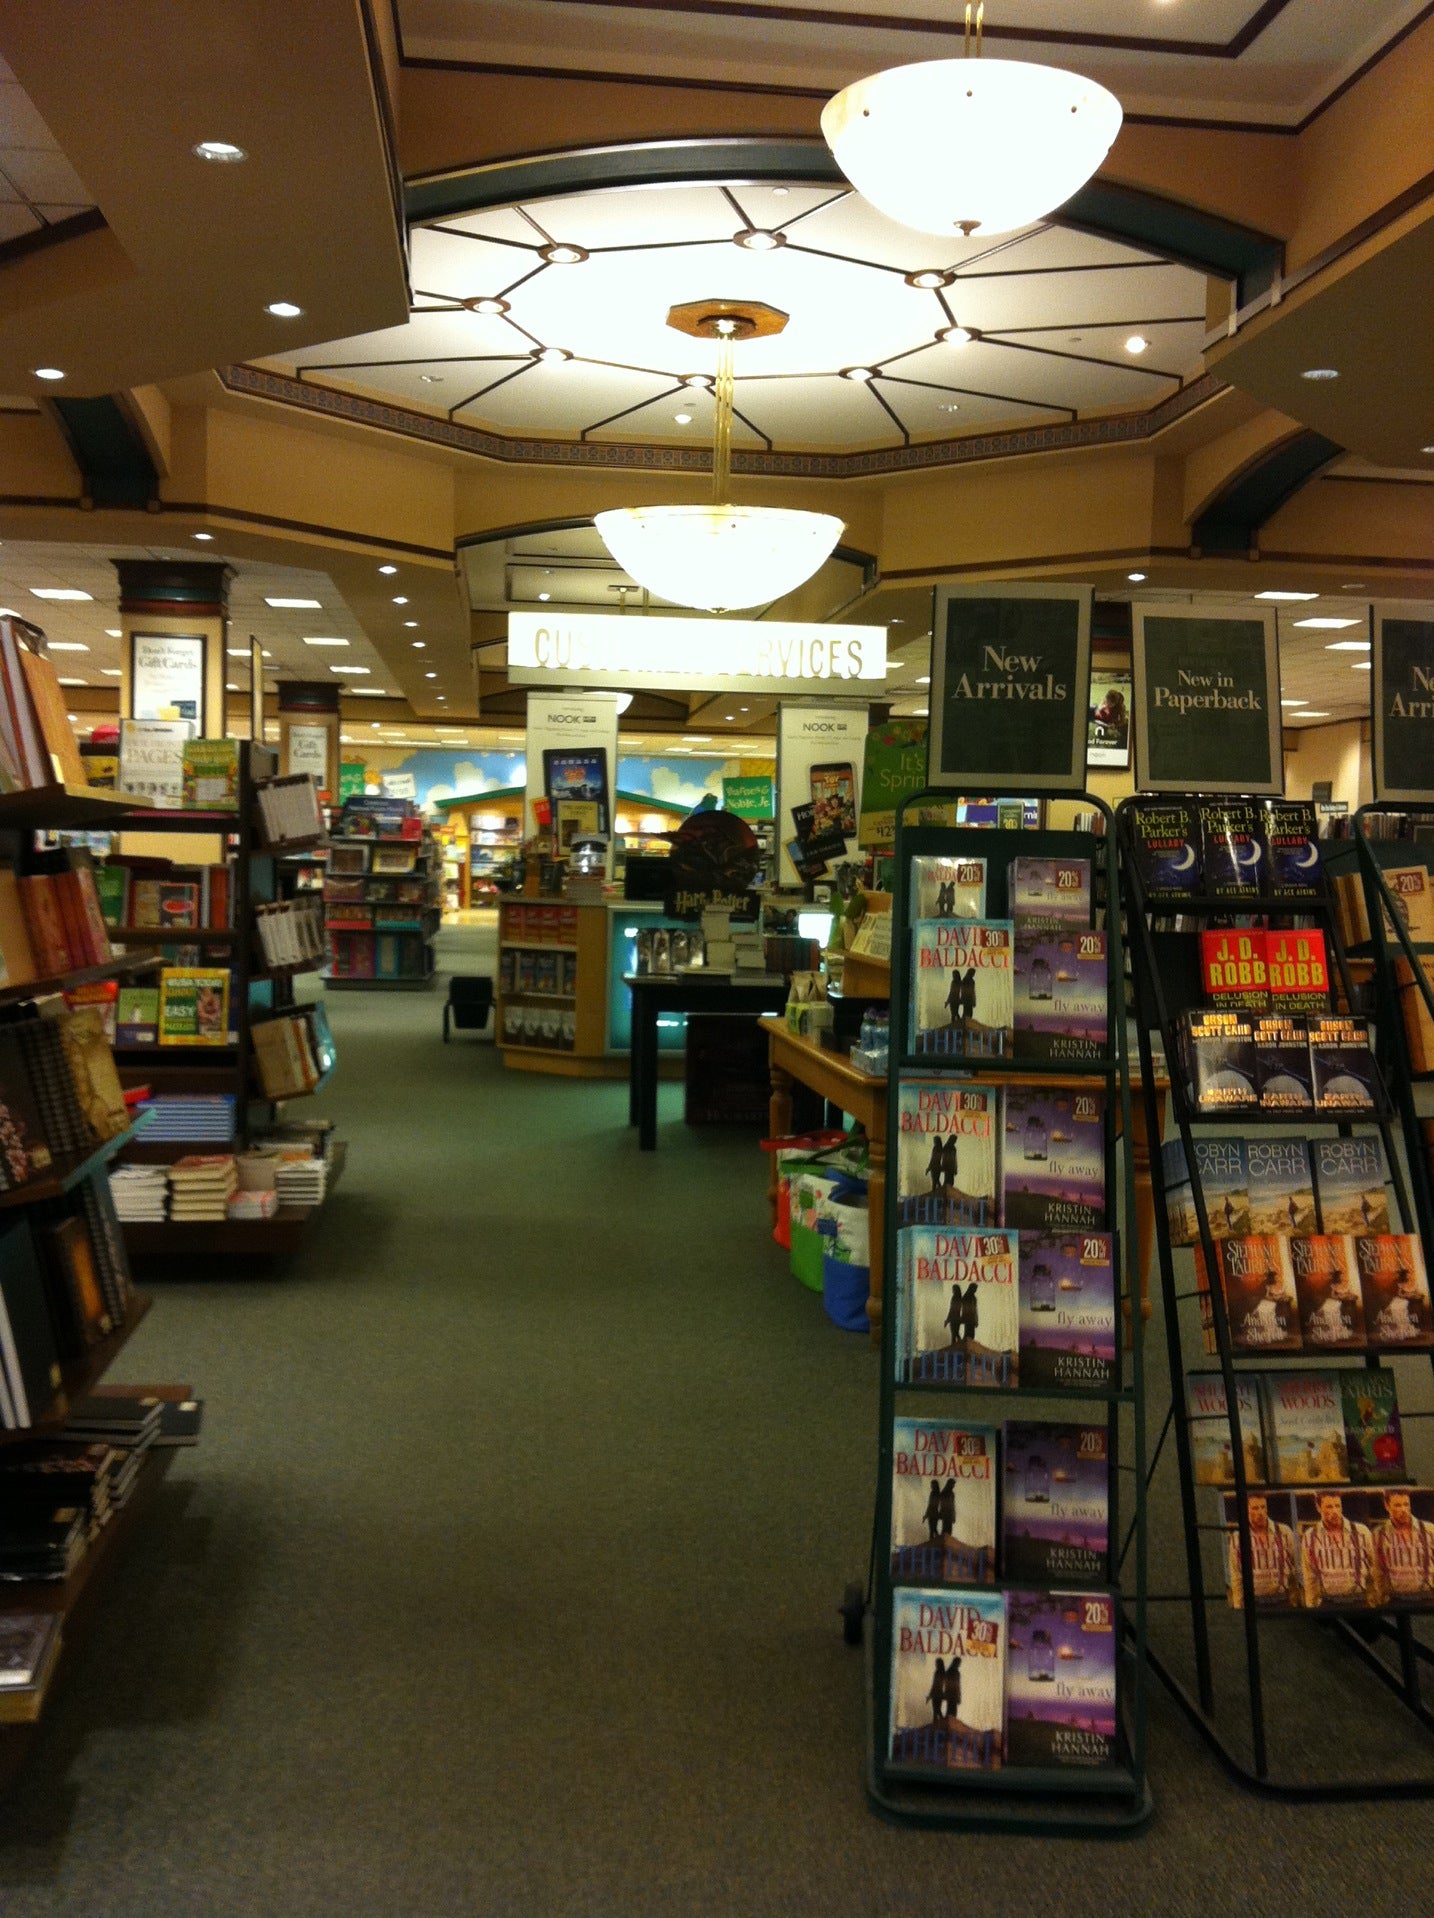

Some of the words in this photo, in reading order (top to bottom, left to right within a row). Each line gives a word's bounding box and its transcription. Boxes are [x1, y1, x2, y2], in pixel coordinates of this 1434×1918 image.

[982, 646, 1043, 673] New
[951, 673, 1067, 700] Arrivals
[1178, 670, 1213, 688] New
[1217, 672, 1234, 688] in
[1154, 687, 1262, 715] Paperback
[548, 715, 581, 724] NOOK
[803, 723, 835, 732] NOOK
[900, 752, 924, 771] It's
[880, 768, 926, 793] Sprin
[1135, 811, 1176, 826] Robert
[1179, 810, 1192, 824] B.
[1201, 806, 1241, 820] Robert
[1244, 806, 1257, 819] B.
[1259, 809, 1299, 823] Robert
[1302, 808, 1314, 821] B.
[1141, 824, 1188, 839] Parker's
[1207, 821, 1253, 834] Parker's
[1265, 823, 1311, 835] Parker's
[1147, 838, 1186, 849] LULLABY
[1058, 869, 1079, 888] 20%
[936, 927, 981, 946] DAVI
[985, 930, 1005, 947] 30%
[1080, 936, 1102, 954] 20%
[919, 947, 1009, 969] BALDACCI
[1217, 938, 1235, 962] J.
[1238, 937, 1259, 960] D.
[1275, 939, 1293, 962] J.
[1296, 939, 1317, 961] D.
[1209, 961, 1267, 987] ROBB
[1268, 963, 1324, 987] ROBB
[1212, 991, 1269, 1001] DELUSION
[1271, 992, 1327, 1001] DELUSION
[1053, 999, 1069, 1013] fly
[1071, 1002, 1105, 1014] away
[1289, 1001, 1325, 1010] DEATH
[1203, 1014, 1238, 1026] ORSON
[1191, 1025, 1222, 1037] SCOTT
[1253, 1031, 1278, 1042] COTT
[1309, 1031, 1339, 1042] SCOTT
[922, 1029, 963, 1053] THE
[965, 1029, 1007, 1057] HIT
[1052, 1039, 1097, 1049] KRISTIN
[1049, 1049, 1101, 1059] HANNAH
[918, 1090, 960, 1112] DAVI
[1075, 1095, 1096, 1115] 20%
[900, 1112, 991, 1137] BALDACCI
[1193, 1143, 1240, 1158] OBYN
[1248, 1143, 1303, 1159] ROBYN
[1320, 1142, 1375, 1158] ROBYN
[1049, 1160, 1064, 1175] fly
[1067, 1164, 1098, 1178] away
[1248, 1158, 1306, 1177] CARR
[1321, 1157, 1379, 1176] CARR
[901, 1196, 941, 1223] THE
[949, 1198, 987, 1227] HIT
[1048, 1202, 1092, 1215] KRISTIN
[1044, 1213, 1096, 1225] HANNAH
[935, 1235, 981, 1258] DAVI
[1083, 1238, 1106, 1259] 20%
[917, 1257, 1013, 1284] BALDACCI
[1057, 1311, 1073, 1328] fly
[1078, 1314, 1112, 1328] away
[919, 1351, 964, 1381] THE
[970, 1353, 1011, 1386] HIT
[1057, 1356, 1105, 1368] KRISTIN
[1054, 1367, 1110, 1378] HANNAH
[1280, 1397, 1336, 1410] WOODS
[914, 1429, 959, 1452] DAVI
[1051, 1502, 1066, 1517] fly
[1069, 1506, 1105, 1520] away
[1051, 1548, 1097, 1561] KRISTIN
[897, 1548, 940, 1578] THE
[946, 1550, 984, 1582] HIT
[1045, 1559, 1100, 1571] HANNAH
[920, 1604, 981, 1630] DAVID
[1085, 1602, 1109, 1625] 20%
[900, 1627, 998, 1658] BALDA
[1056, 1682, 1073, 1697] fly
[1078, 1685, 1113, 1699] away
[1055, 1731, 1105, 1743] KRISTIN
[901, 1729, 946, 1762] THE
[950, 1730, 993, 1768] HIT
[1051, 1742, 1110, 1755] HANNAH
